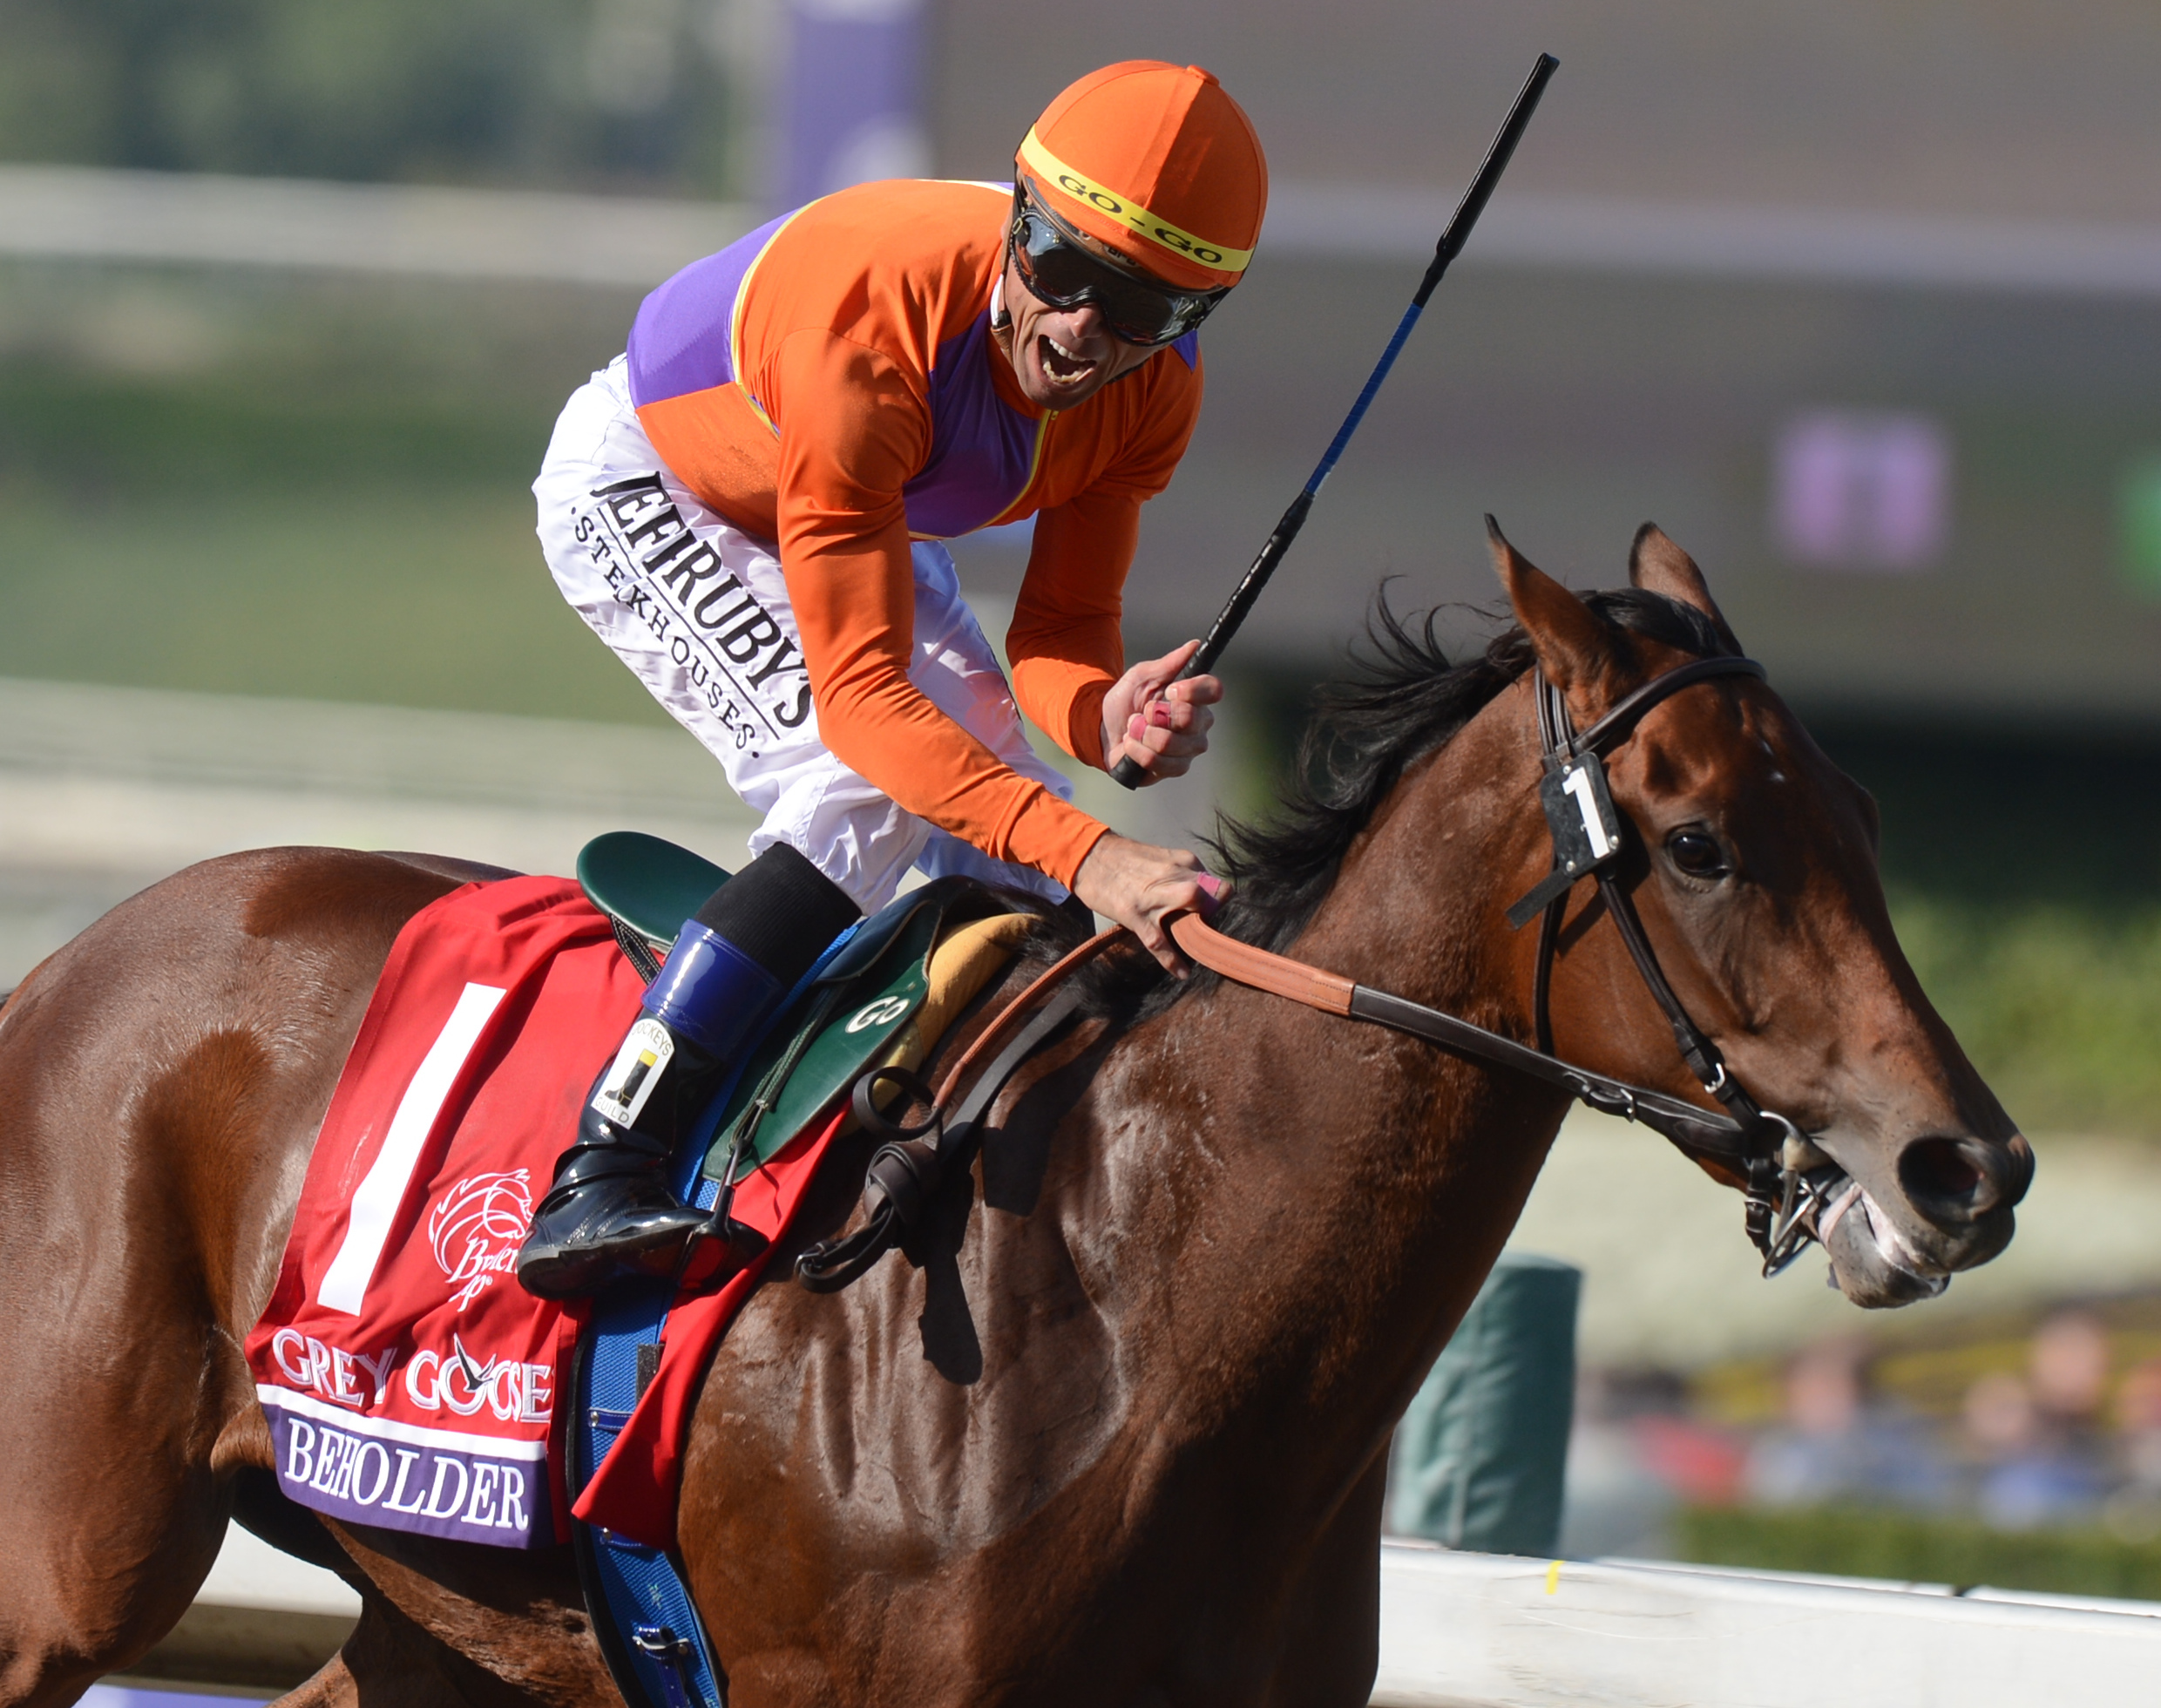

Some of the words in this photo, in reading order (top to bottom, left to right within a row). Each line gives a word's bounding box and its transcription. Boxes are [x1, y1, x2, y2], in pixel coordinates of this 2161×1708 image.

[574, 516, 756, 750] STEKHOUSES
[1561, 766, 1610, 859] 1
[631, 1021, 672, 1056] JOCKEYS
[317, 982, 506, 1317] 1
[594, 1095, 631, 1124] GUILD
[272, 1328, 398, 1407] GREY
[405, 1347, 552, 1424] GOOSE
[283, 1417, 529, 1531] BEHOLDER
